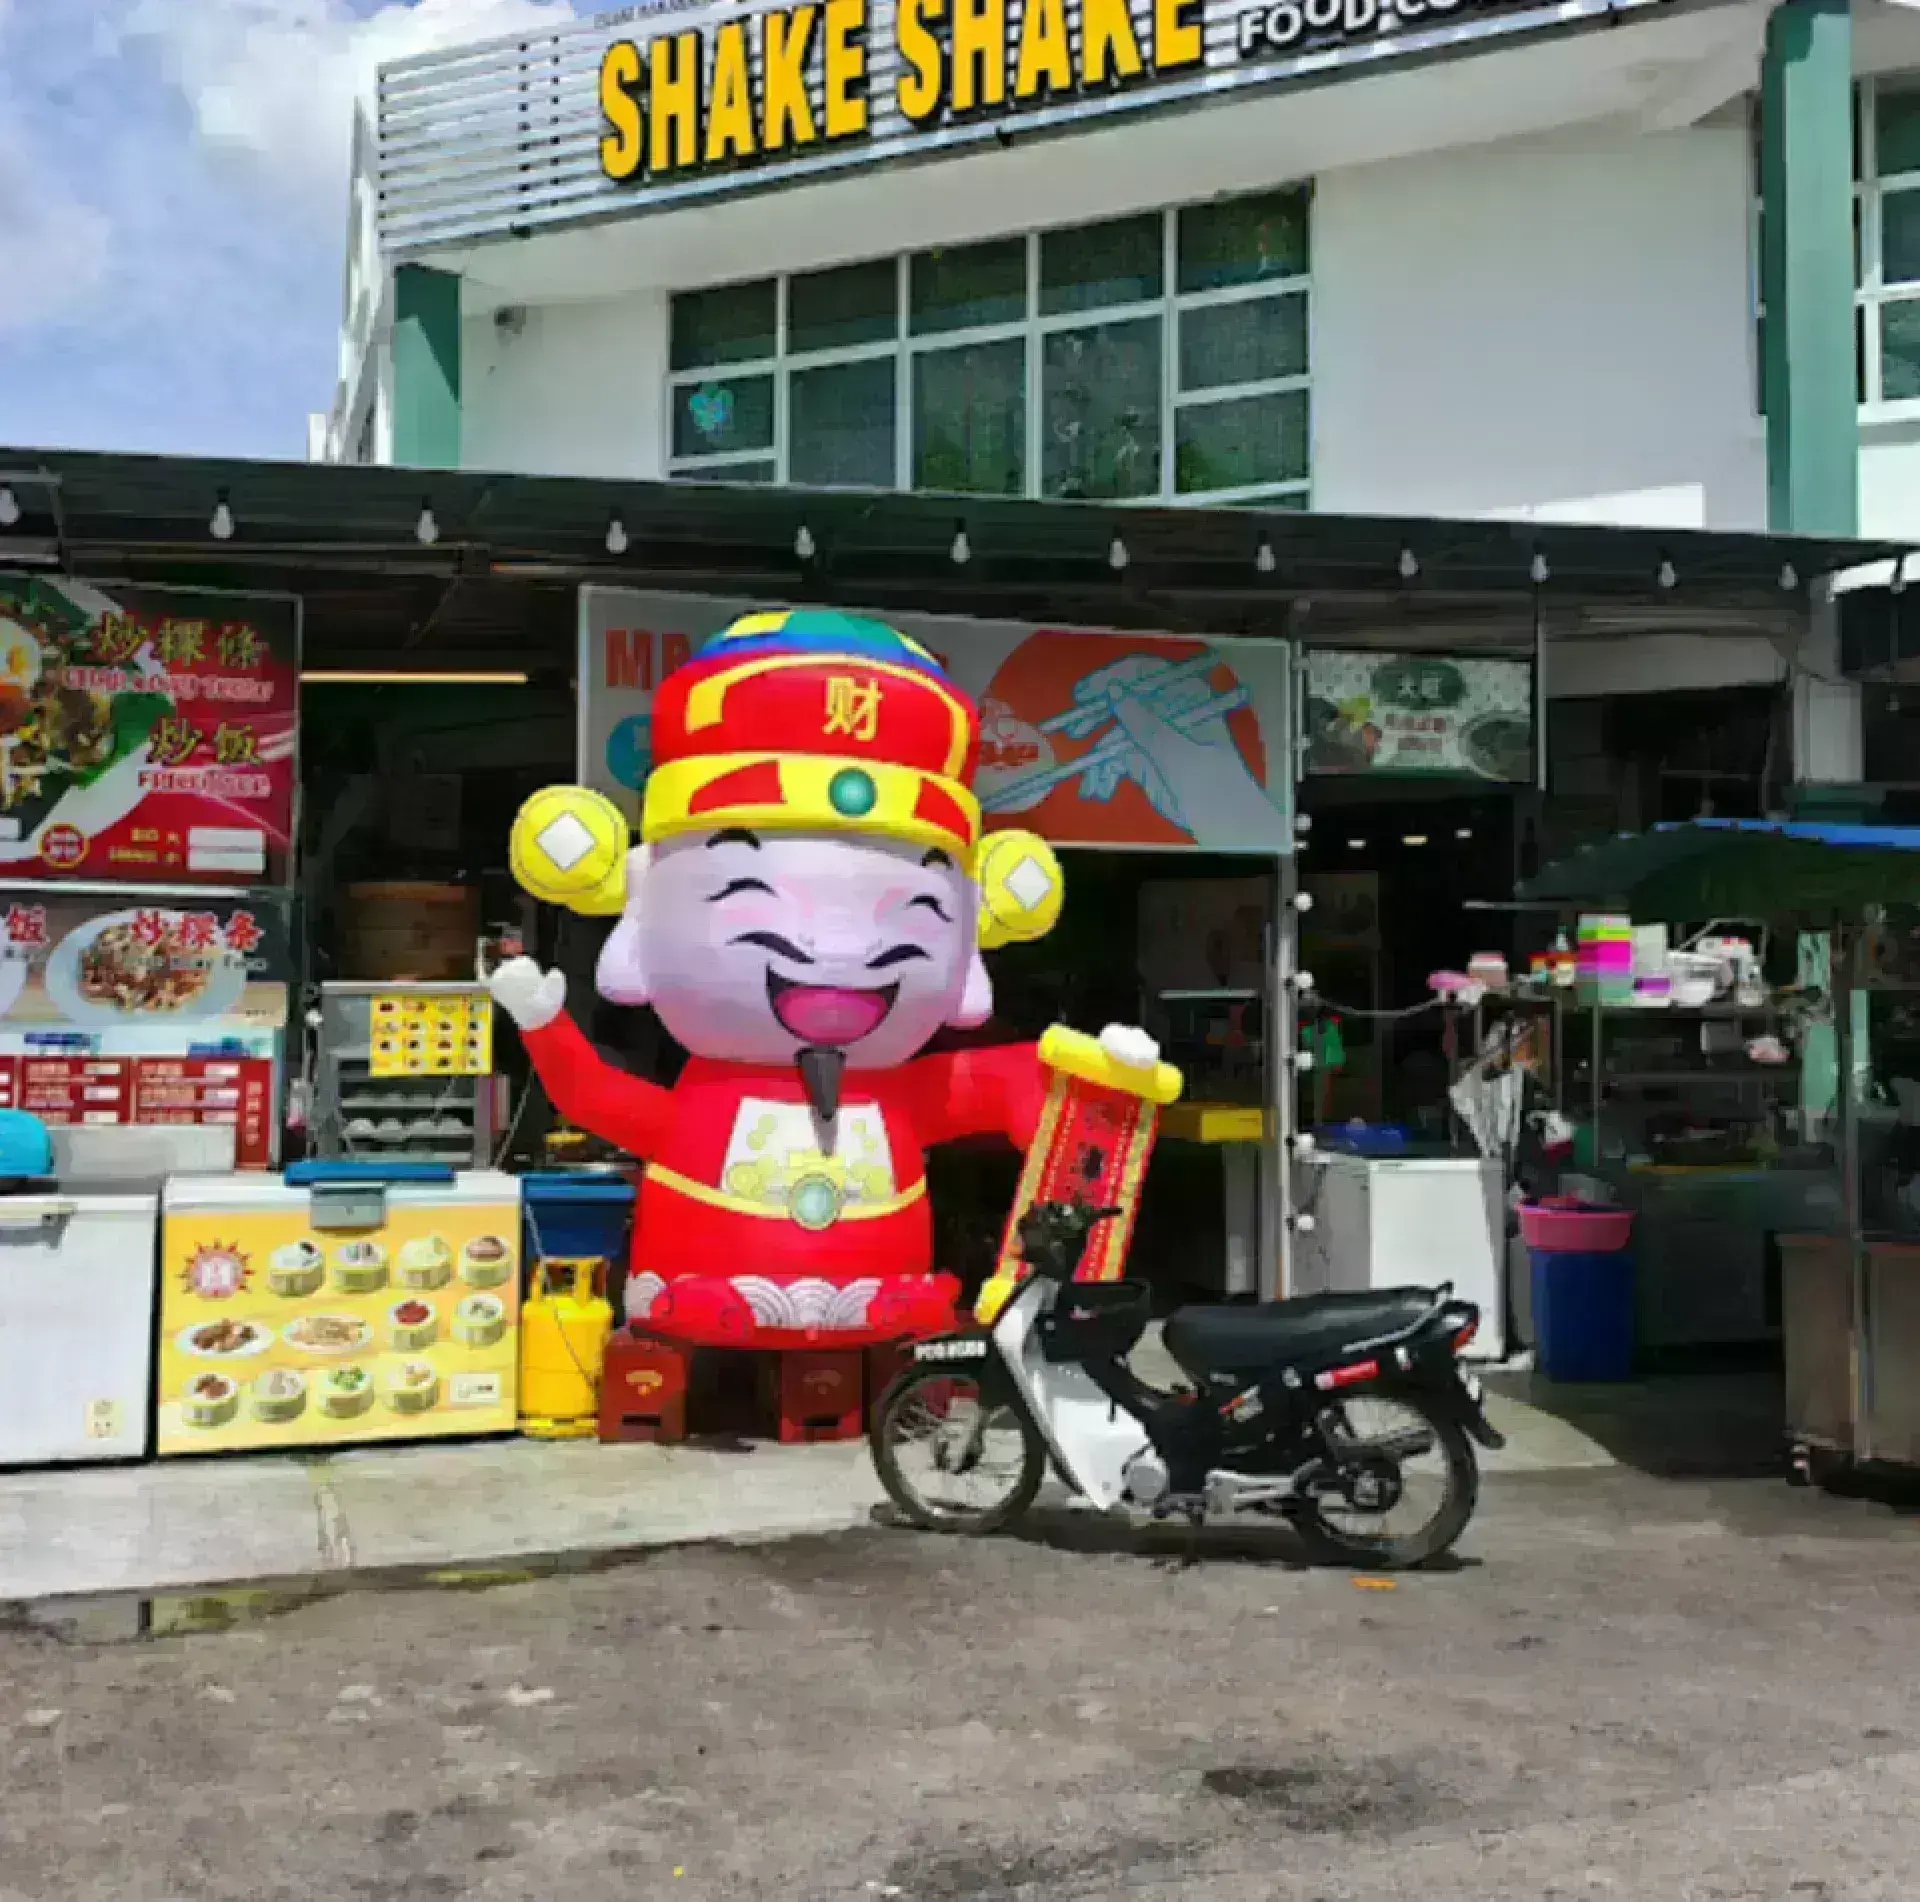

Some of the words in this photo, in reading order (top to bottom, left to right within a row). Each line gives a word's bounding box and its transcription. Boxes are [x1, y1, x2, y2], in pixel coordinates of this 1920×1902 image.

[1240, 0, 1377, 49] FOOD
[601, 0, 867, 179] SHAKE
[822, 676, 884, 741] 财
